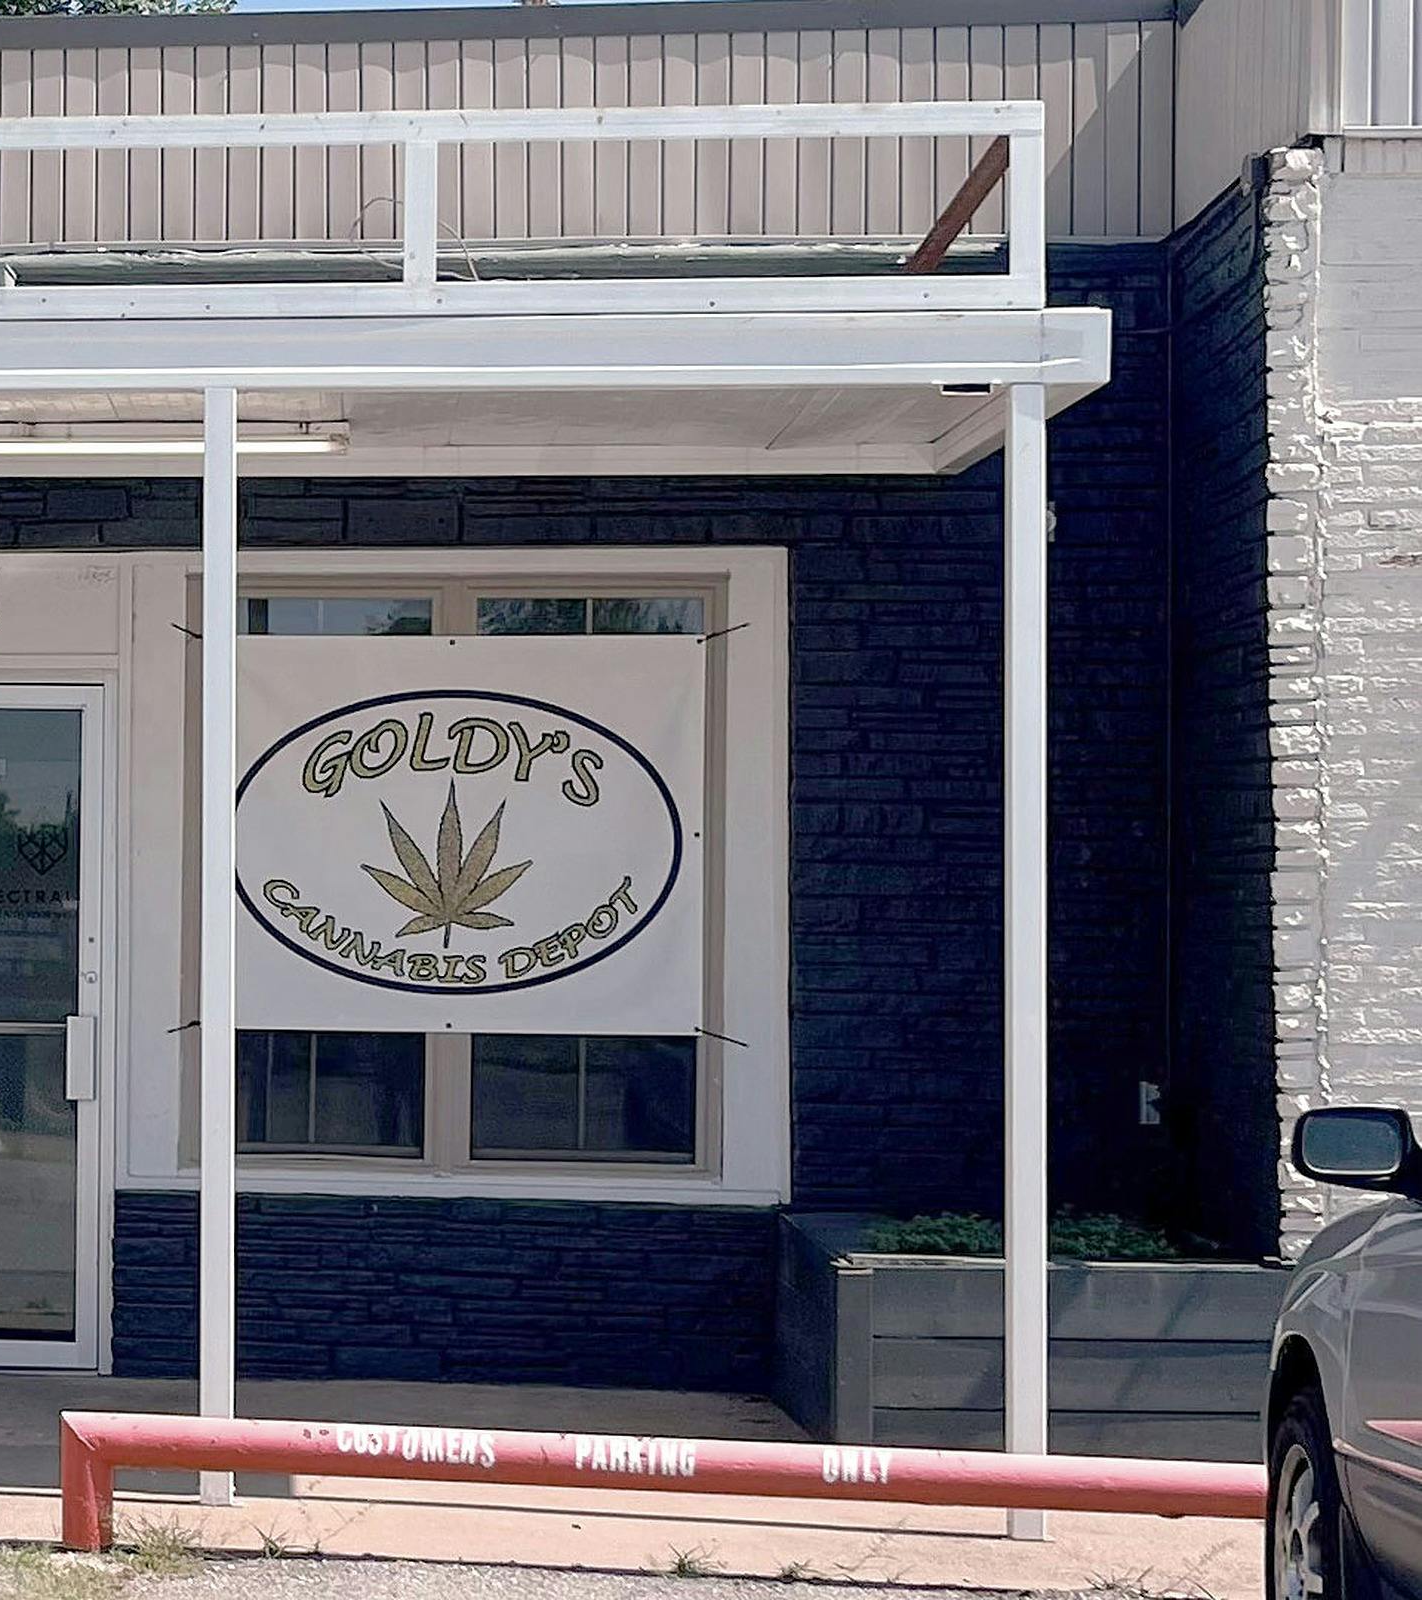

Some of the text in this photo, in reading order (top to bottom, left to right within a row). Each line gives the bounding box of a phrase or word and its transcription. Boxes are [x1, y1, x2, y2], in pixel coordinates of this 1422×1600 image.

[302, 711, 604, 807] GOLDY'S
[262, 876, 639, 984] CANNABIS DEPOT
[336, 1426, 892, 1484] CUSTOMERS PARKING ONLY
